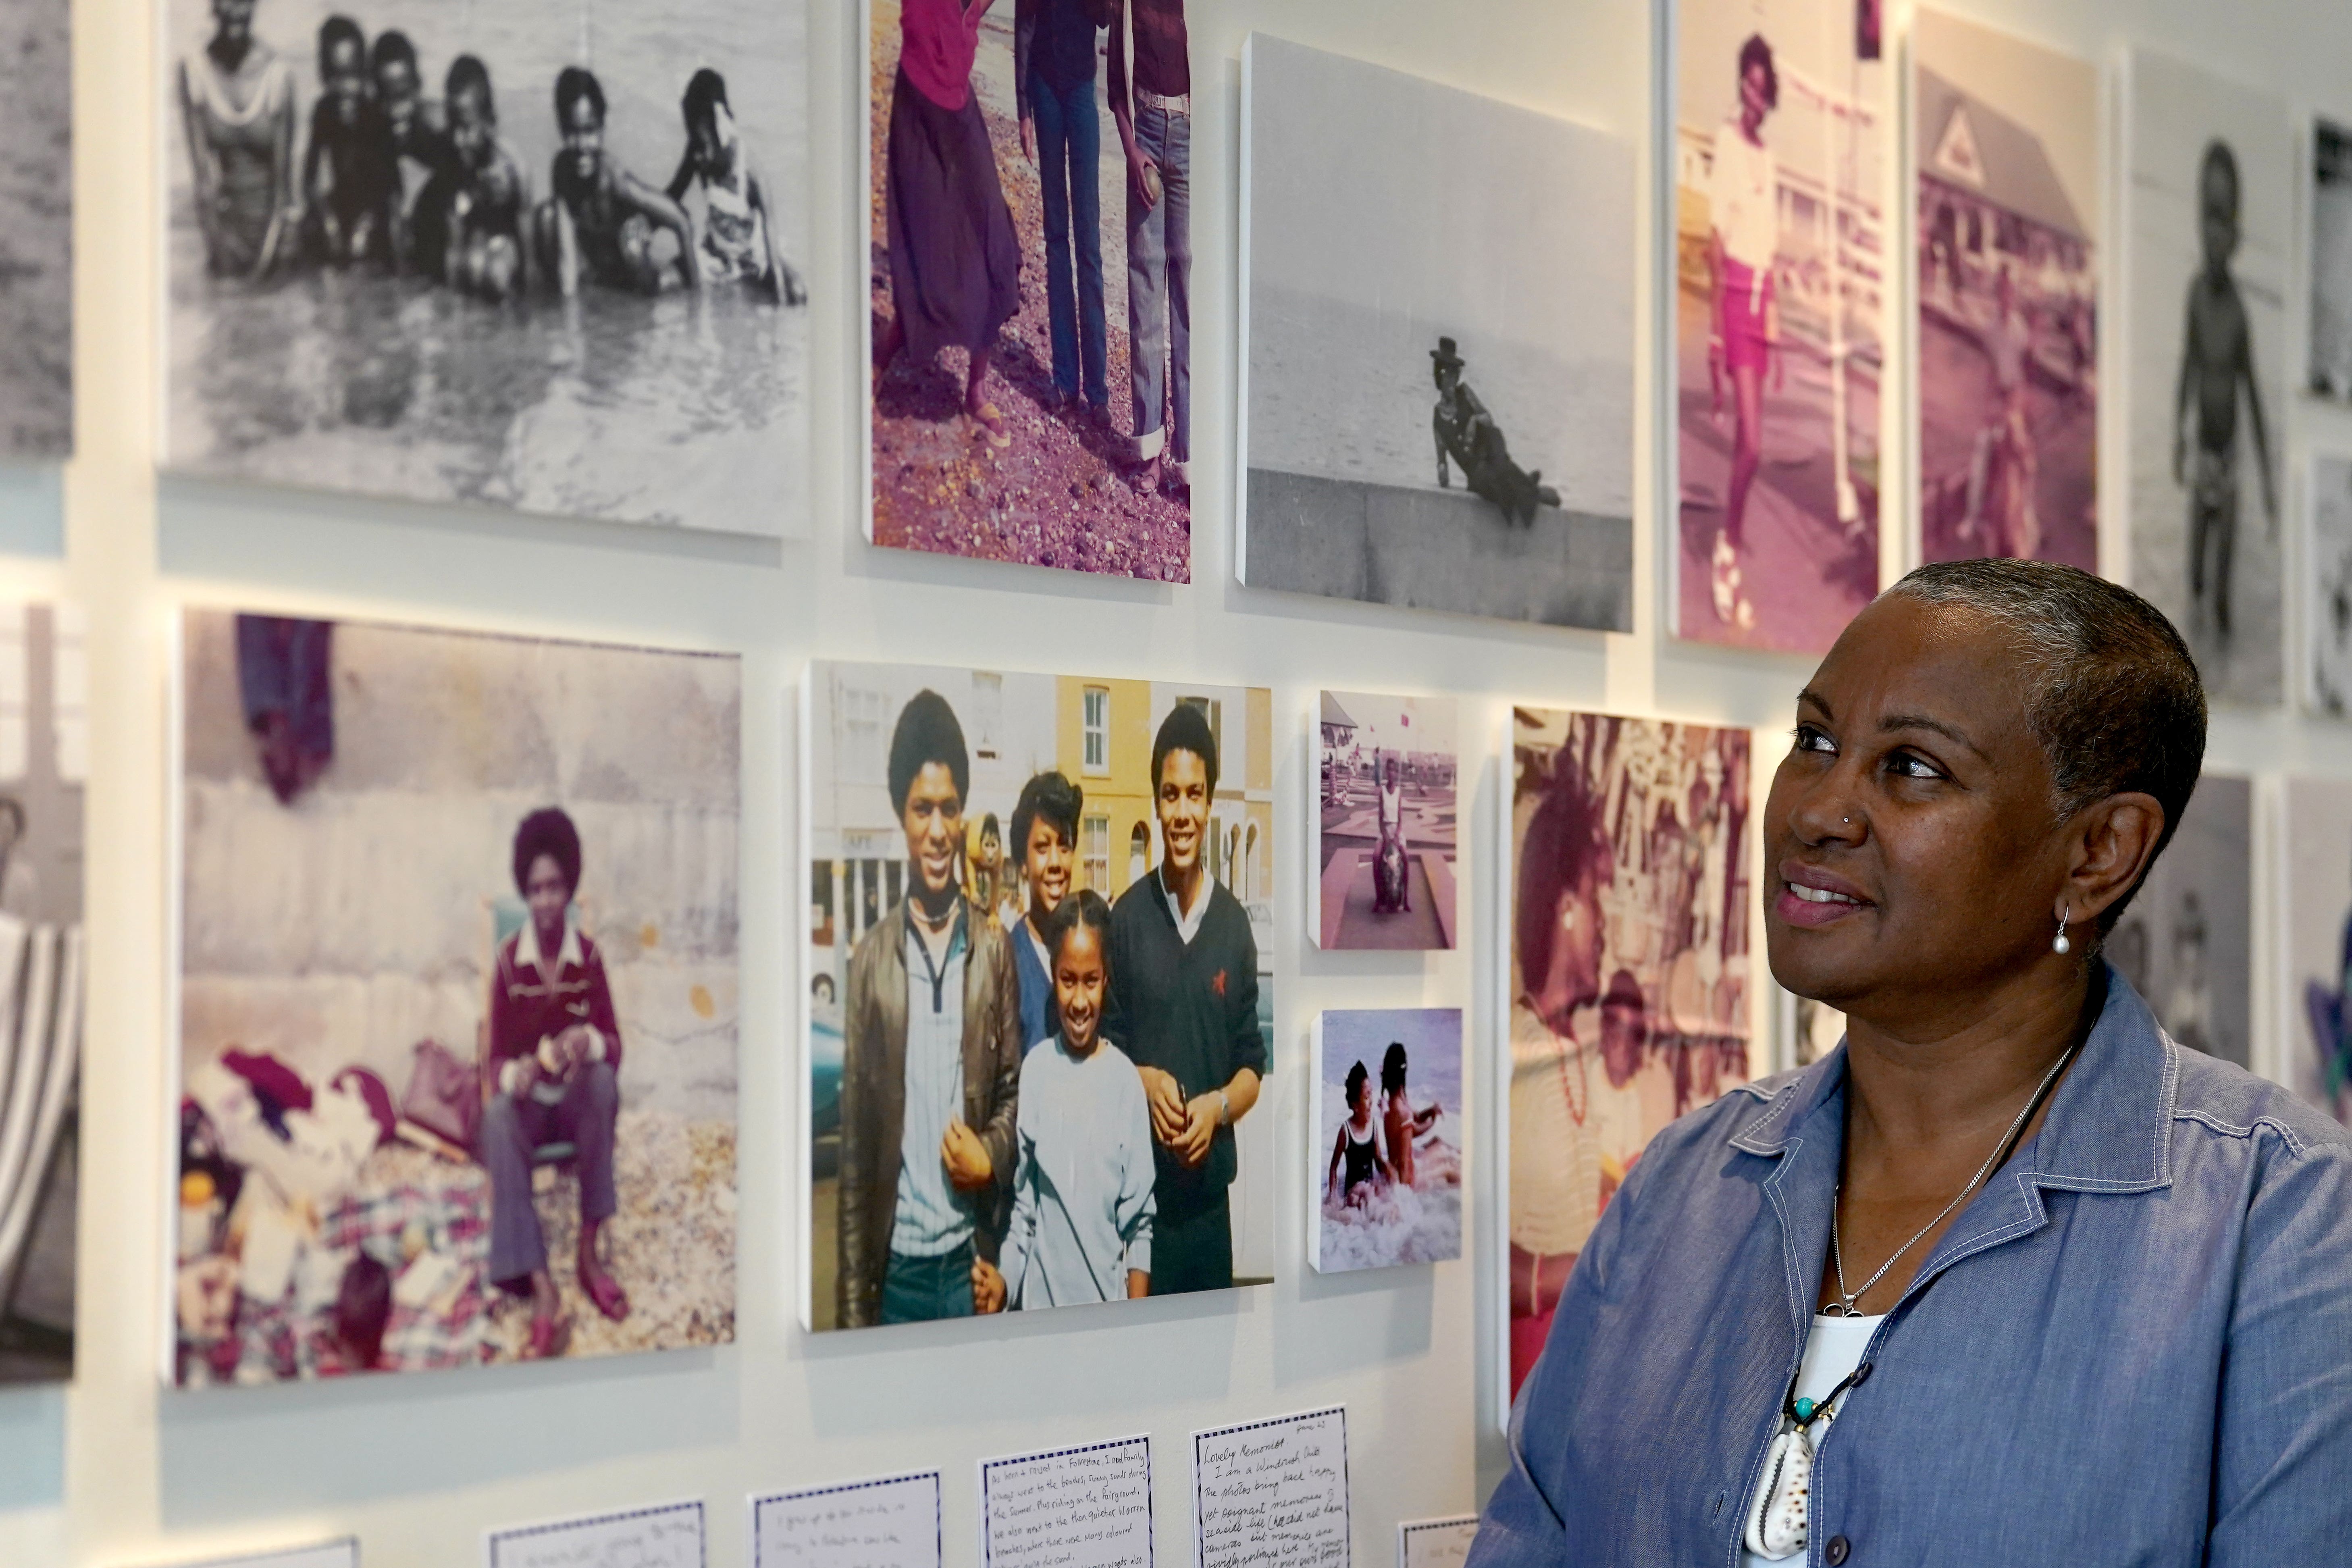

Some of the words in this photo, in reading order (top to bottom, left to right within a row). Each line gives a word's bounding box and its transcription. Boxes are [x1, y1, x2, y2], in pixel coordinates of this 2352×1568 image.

[1056, 1460, 1064, 1469] in
[1105, 1454, 1110, 1464] I
[1124, 1447, 1144, 1467] family
[1204, 1445, 1236, 1467] Lovely
[1215, 1466, 1222, 1478] I
[1256, 1451, 1300, 1472] Windrush
[1038, 1483, 1044, 1492] to
[1047, 1479, 1058, 1489] the
[1129, 1468, 1146, 1480] during
[1204, 1487, 1217, 1498] The
[1221, 1482, 1250, 1502] photos
[1254, 1477, 1279, 1496] bring
[1283, 1470, 1305, 1483] back
[1052, 1493, 1074, 1508] riding
[1086, 1491, 1097, 1503] the
[1009, 1524, 1022, 1537] also
[1045, 1521, 1052, 1530] to
[1056, 1516, 1067, 1527] the
[1088, 1507, 1115, 1522] quieter
[1204, 1508, 1219, 1528] yet
[1206, 1519, 1242, 1538] seaside
[1246, 1515, 1265, 1534] life
[1205, 1540, 1241, 1553] cameras
